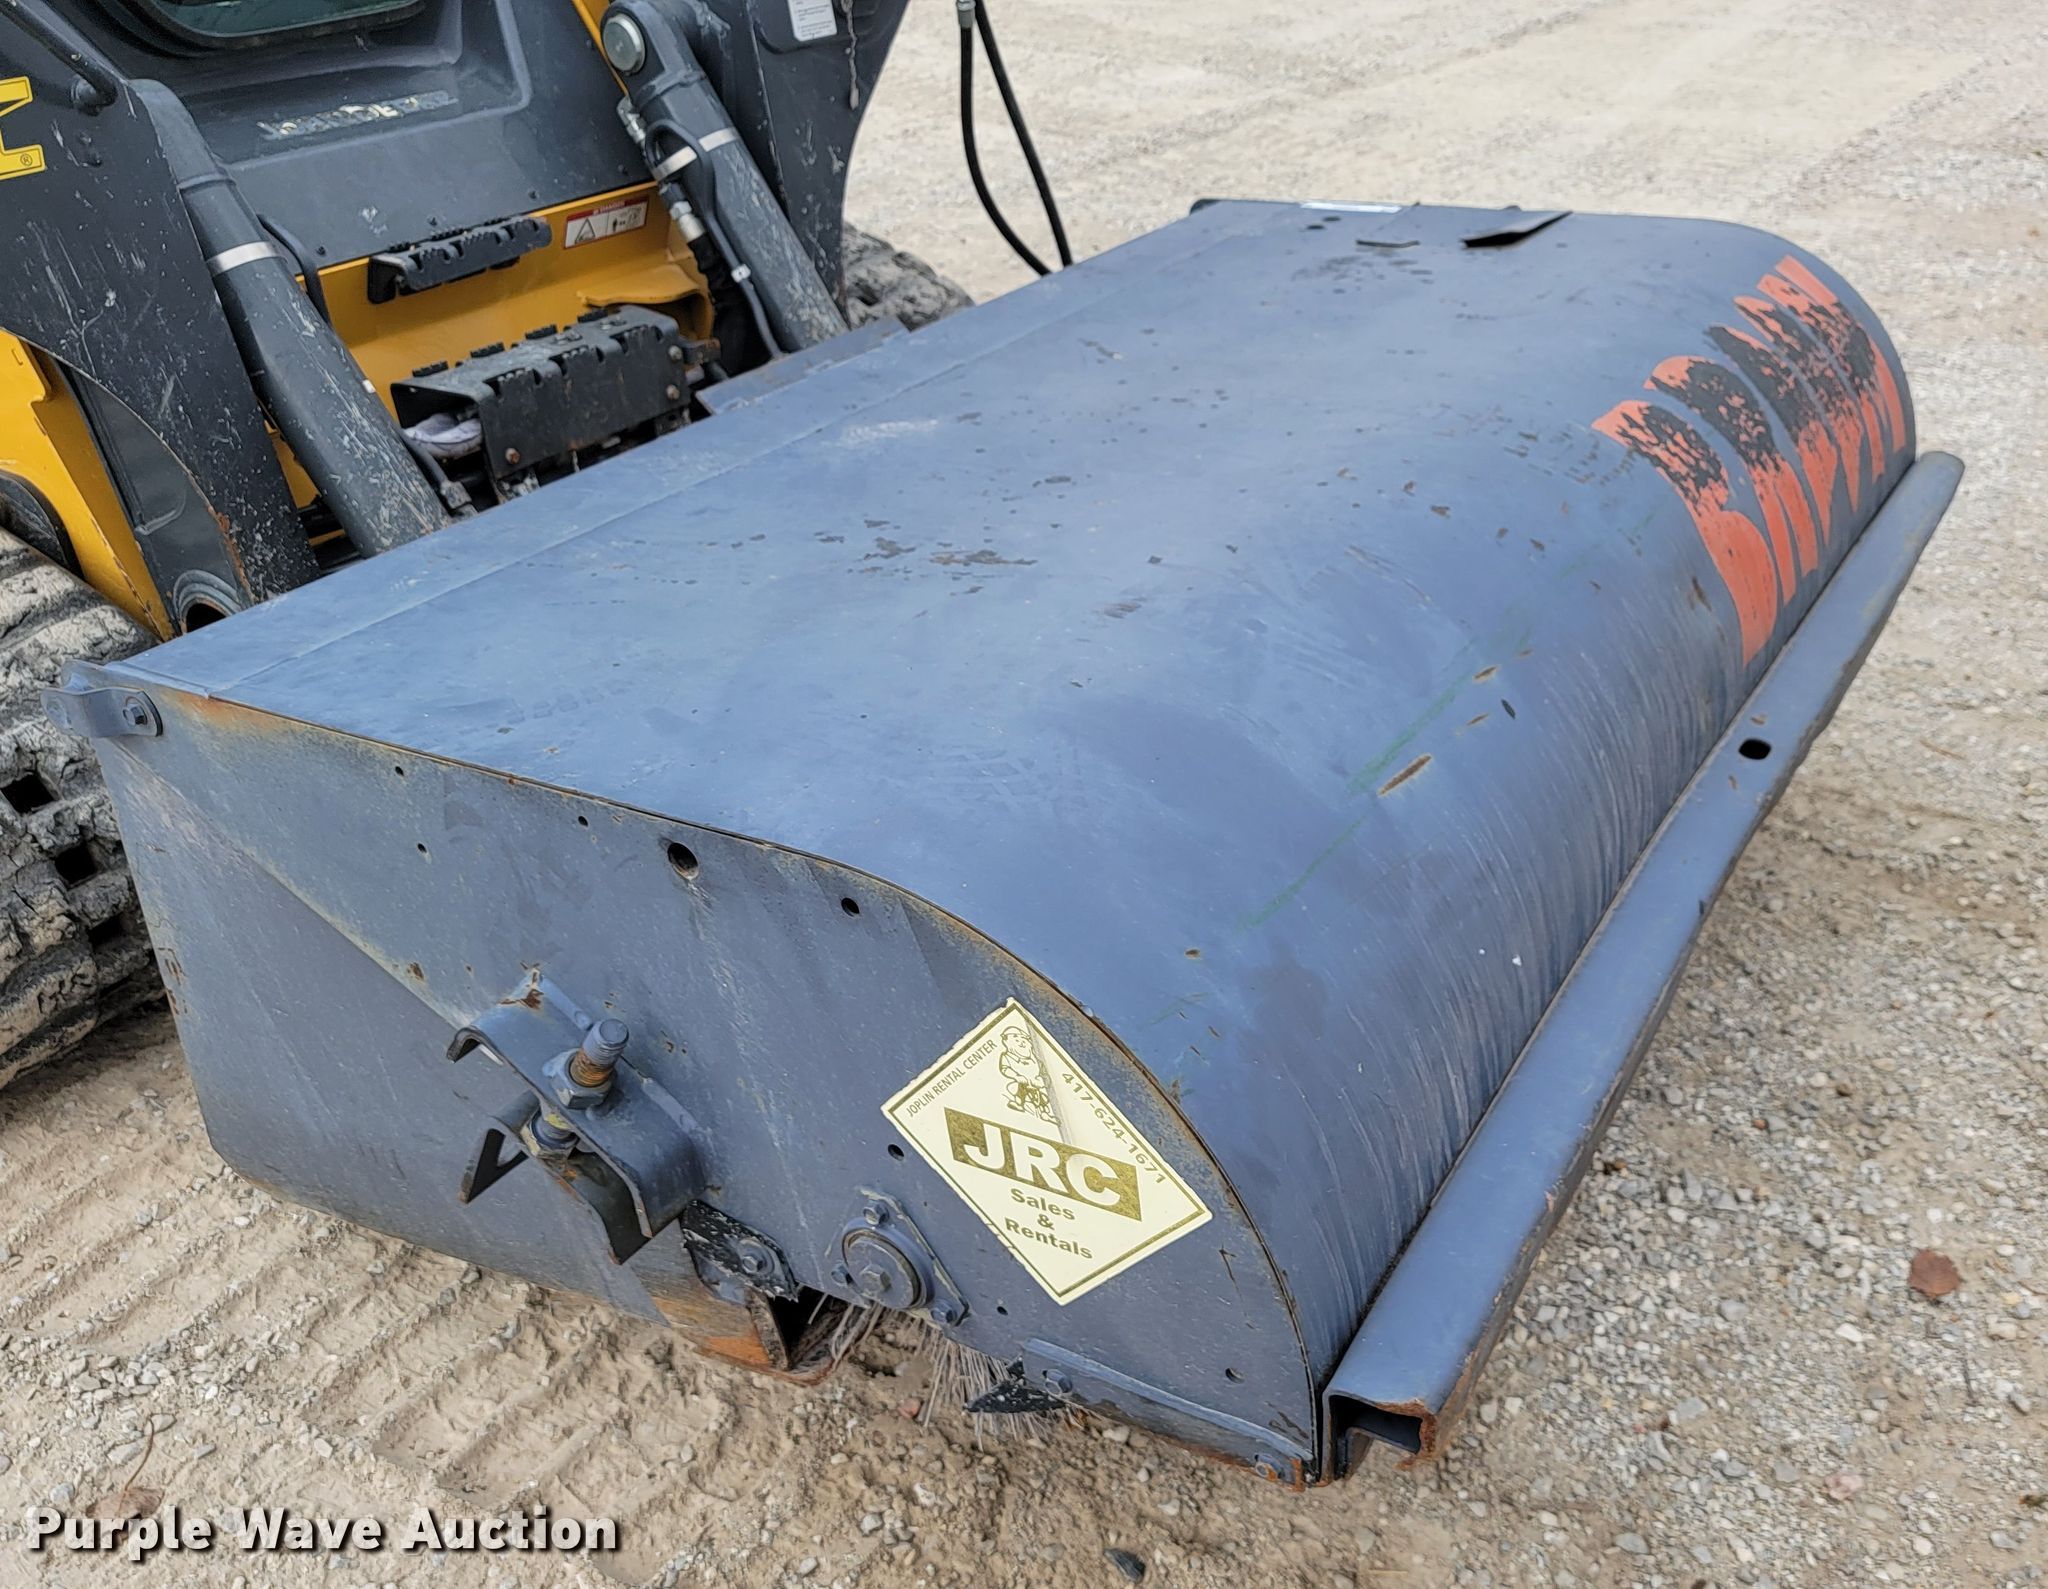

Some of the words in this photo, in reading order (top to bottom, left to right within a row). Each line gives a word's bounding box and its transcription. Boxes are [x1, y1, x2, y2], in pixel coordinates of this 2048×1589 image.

[906, 1090, 935, 1118] JOPLIN
[932, 1067, 966, 1096] RENTAL
[962, 1039, 998, 1070] CENTER
[1061, 1072, 1167, 1184] 417-624-1671
[963, 1122, 1121, 1206] JRC
[1010, 1187, 1076, 1221] Sales
[1037, 1213, 1056, 1231] &
[1004, 1217, 1093, 1260] Rentals
